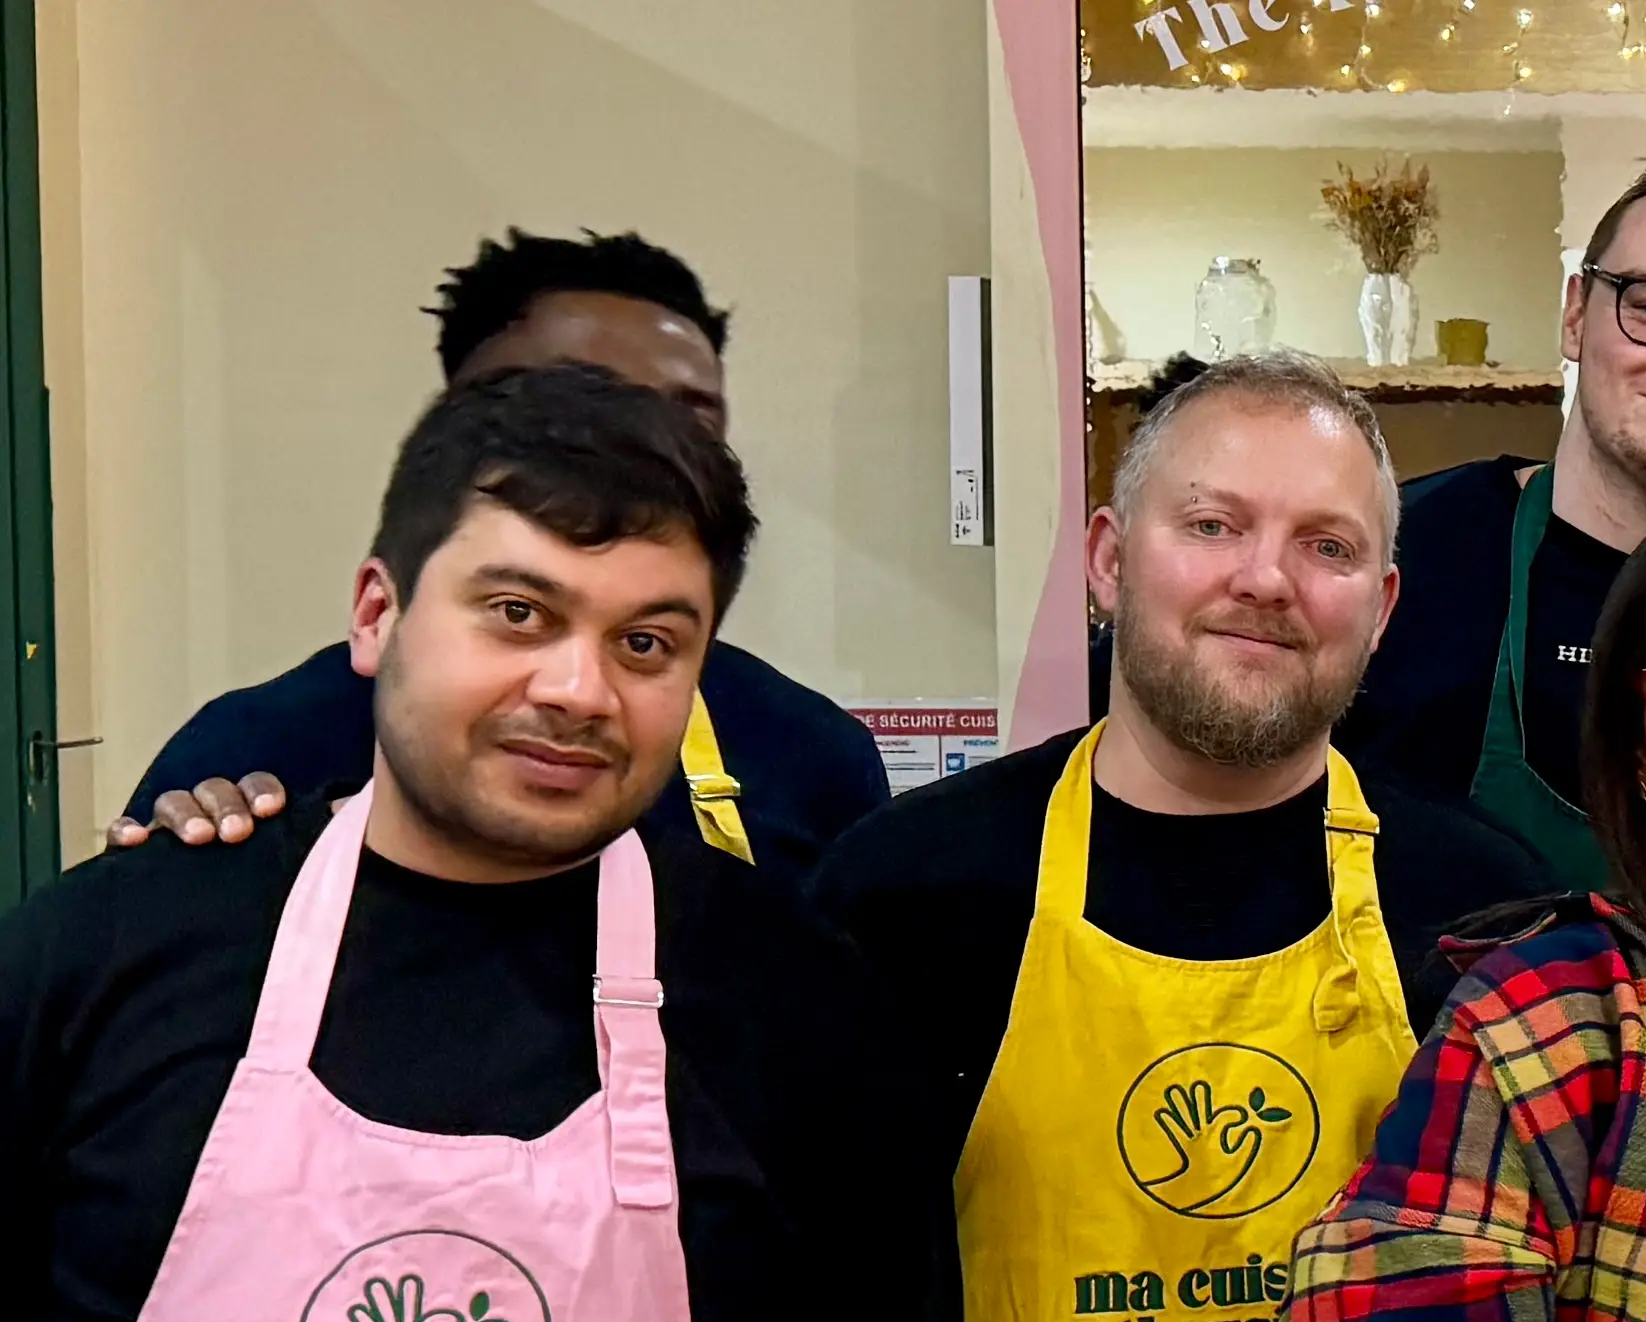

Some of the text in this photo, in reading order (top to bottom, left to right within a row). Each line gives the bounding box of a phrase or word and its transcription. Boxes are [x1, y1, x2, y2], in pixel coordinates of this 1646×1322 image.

[879, 711, 956, 728] SÉCURITÉ
[1075, 1252, 1289, 1314] ma cuis
